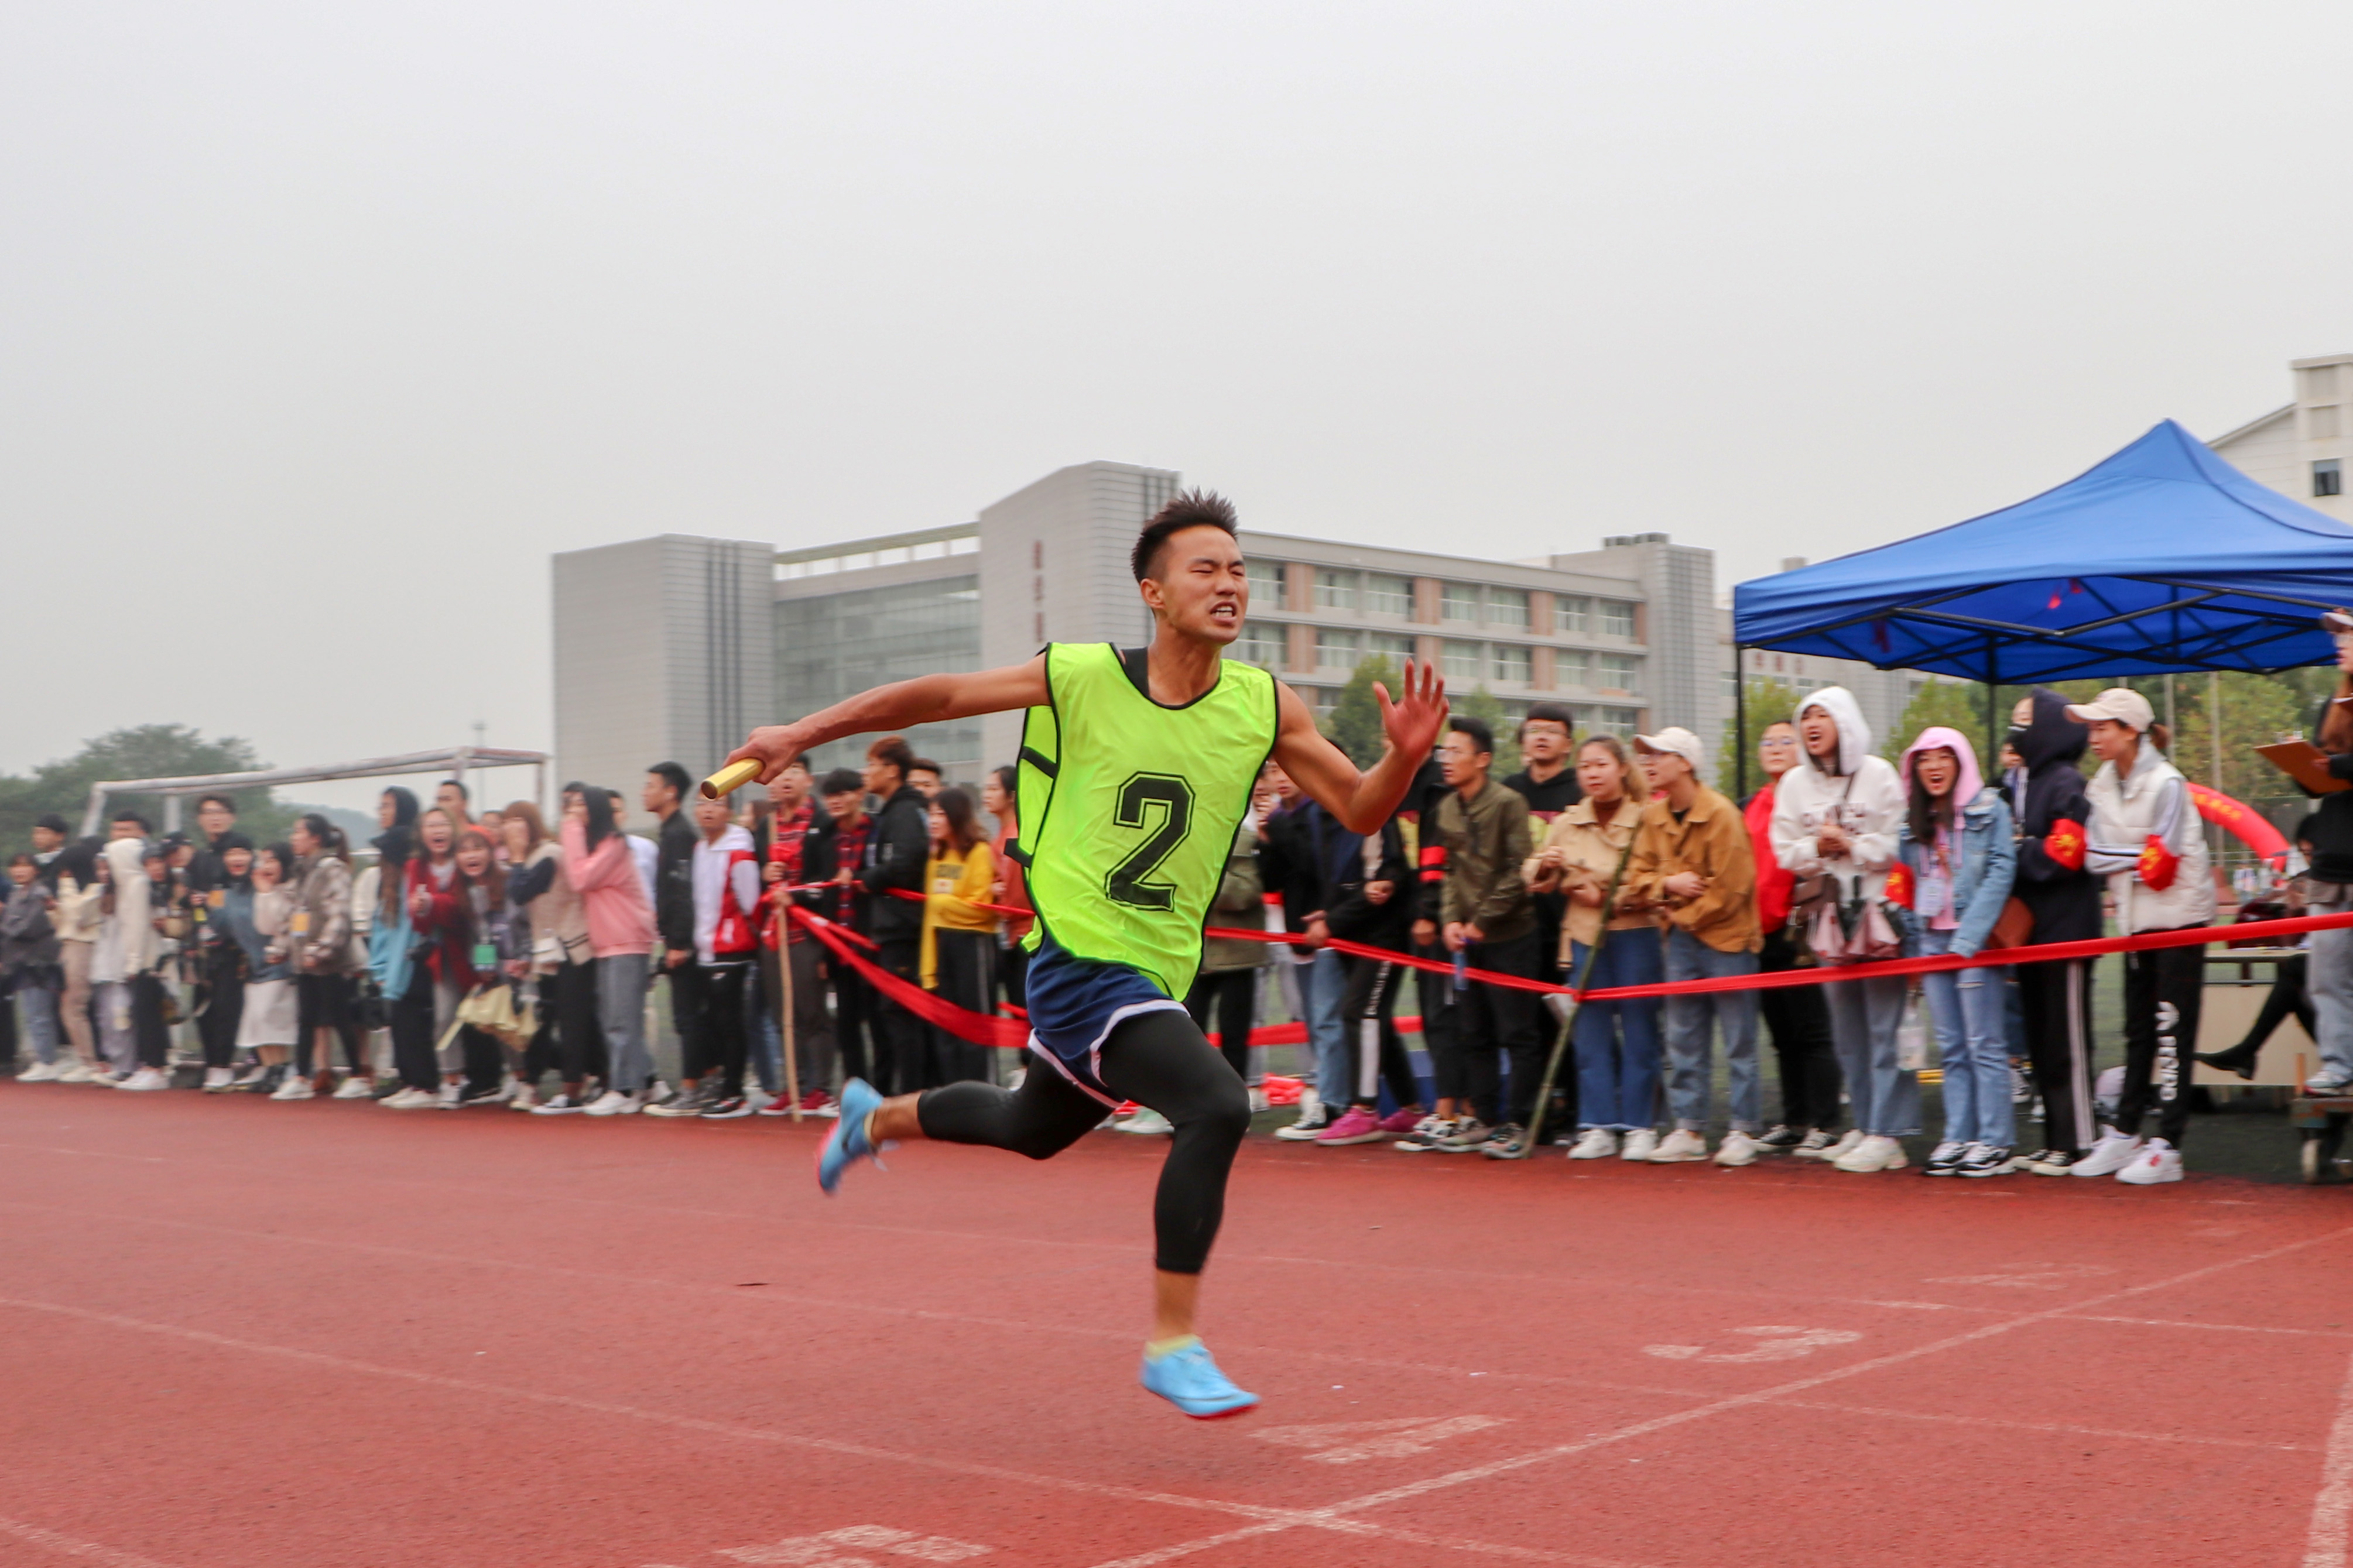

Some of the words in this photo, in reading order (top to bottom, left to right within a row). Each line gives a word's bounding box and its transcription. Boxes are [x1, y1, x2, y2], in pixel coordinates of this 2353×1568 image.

[1104, 771, 1196, 912] 2
[1640, 1325, 1863, 1363] 3
[1247, 1415, 1516, 1463] 4
